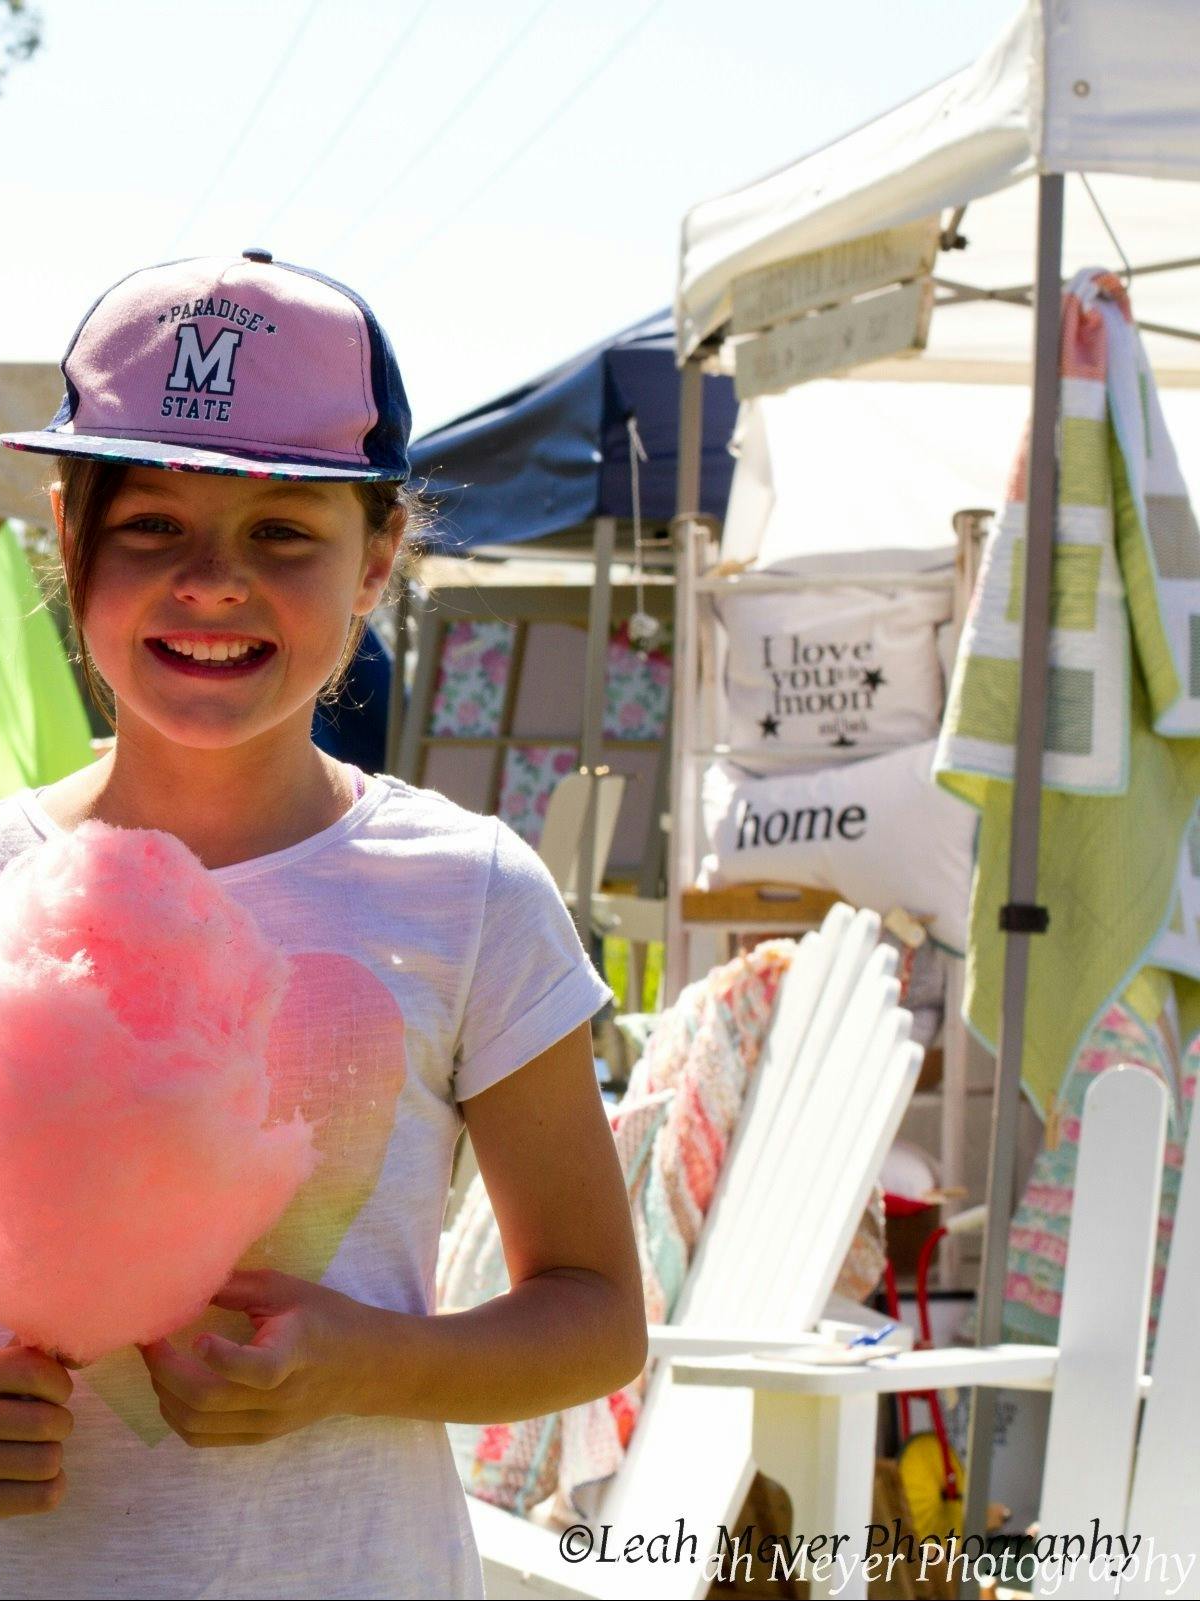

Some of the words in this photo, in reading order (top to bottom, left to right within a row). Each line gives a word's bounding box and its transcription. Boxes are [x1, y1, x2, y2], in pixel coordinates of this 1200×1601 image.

[170, 298, 264, 332] PARADISE
[165, 323, 243, 396] M
[161, 396, 232, 422] STATE
[762, 635, 773, 669] I
[792, 634, 873, 666] love
[736, 802, 868, 851] home
